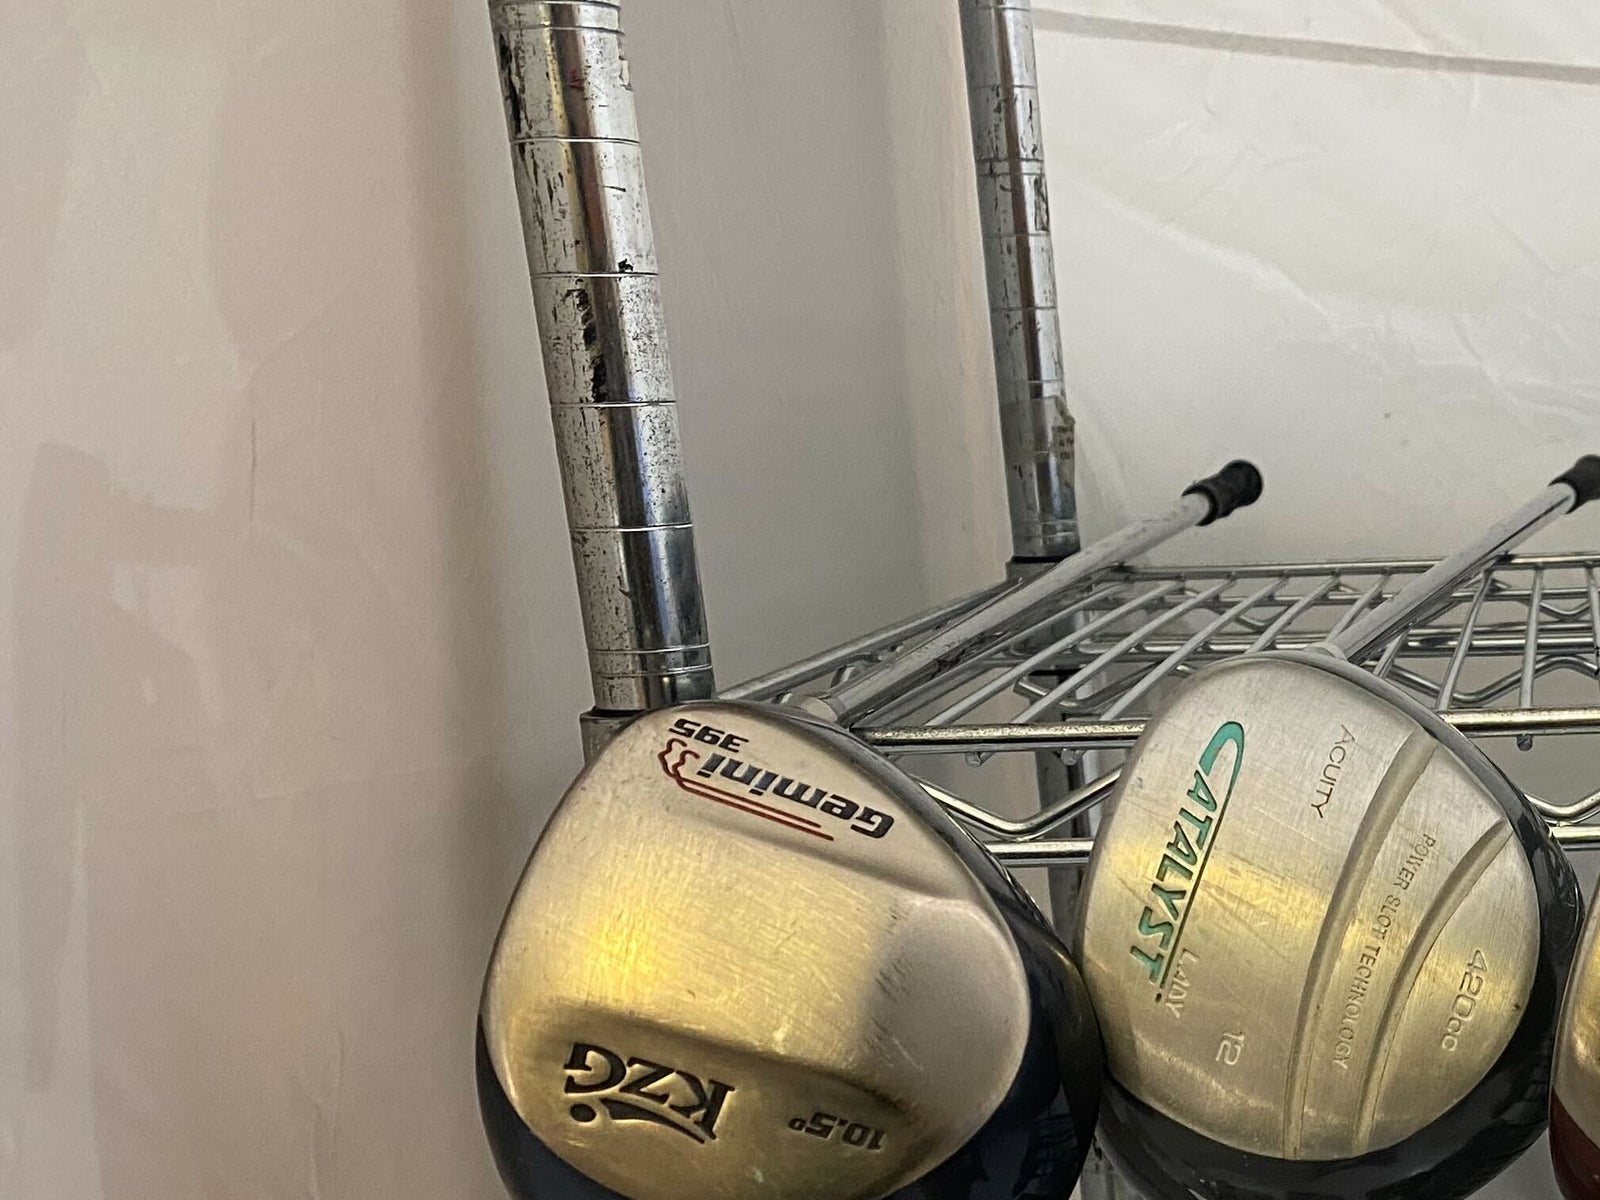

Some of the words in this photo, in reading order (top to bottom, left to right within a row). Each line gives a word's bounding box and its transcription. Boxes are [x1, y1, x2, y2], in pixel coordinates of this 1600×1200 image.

[669, 717, 750, 753] 395
[1310, 723, 1356, 820] ACUITY
[696, 752, 897, 839] Gemini
[1130, 720, 1245, 986] CATALYST
[1393, 833, 1437, 891] POWER
[1370, 893, 1402, 940] SLOT
[1166, 946, 1201, 1019] LADY
[1331, 942, 1382, 1071] TECHNOLOGY
[1440, 947, 1488, 1052] 420cc
[563, 1042, 736, 1141] KZG
[1215, 1029, 1246, 1067] 12
